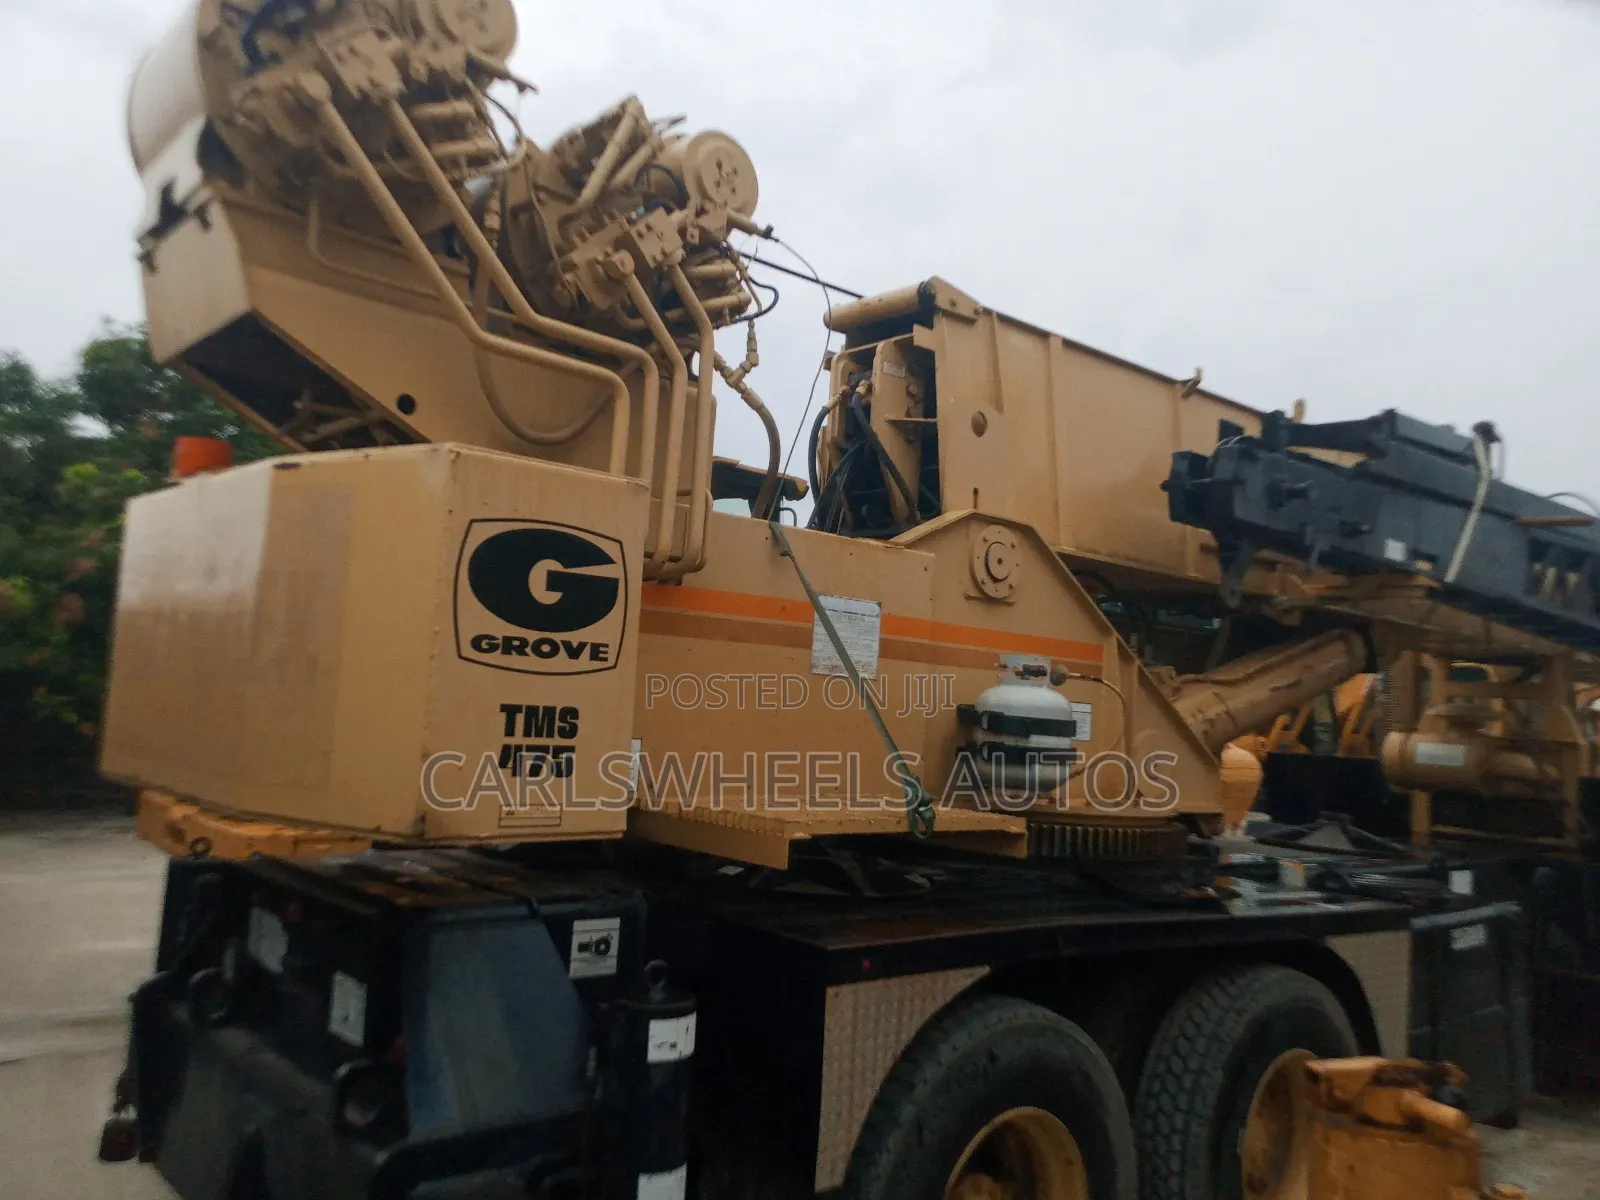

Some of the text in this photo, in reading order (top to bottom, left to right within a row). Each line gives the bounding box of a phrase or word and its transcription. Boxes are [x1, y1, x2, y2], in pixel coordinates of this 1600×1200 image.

[470, 634, 609, 662] GROVE
[500, 704, 579, 739] TMS
[499, 744, 576, 778] 475
